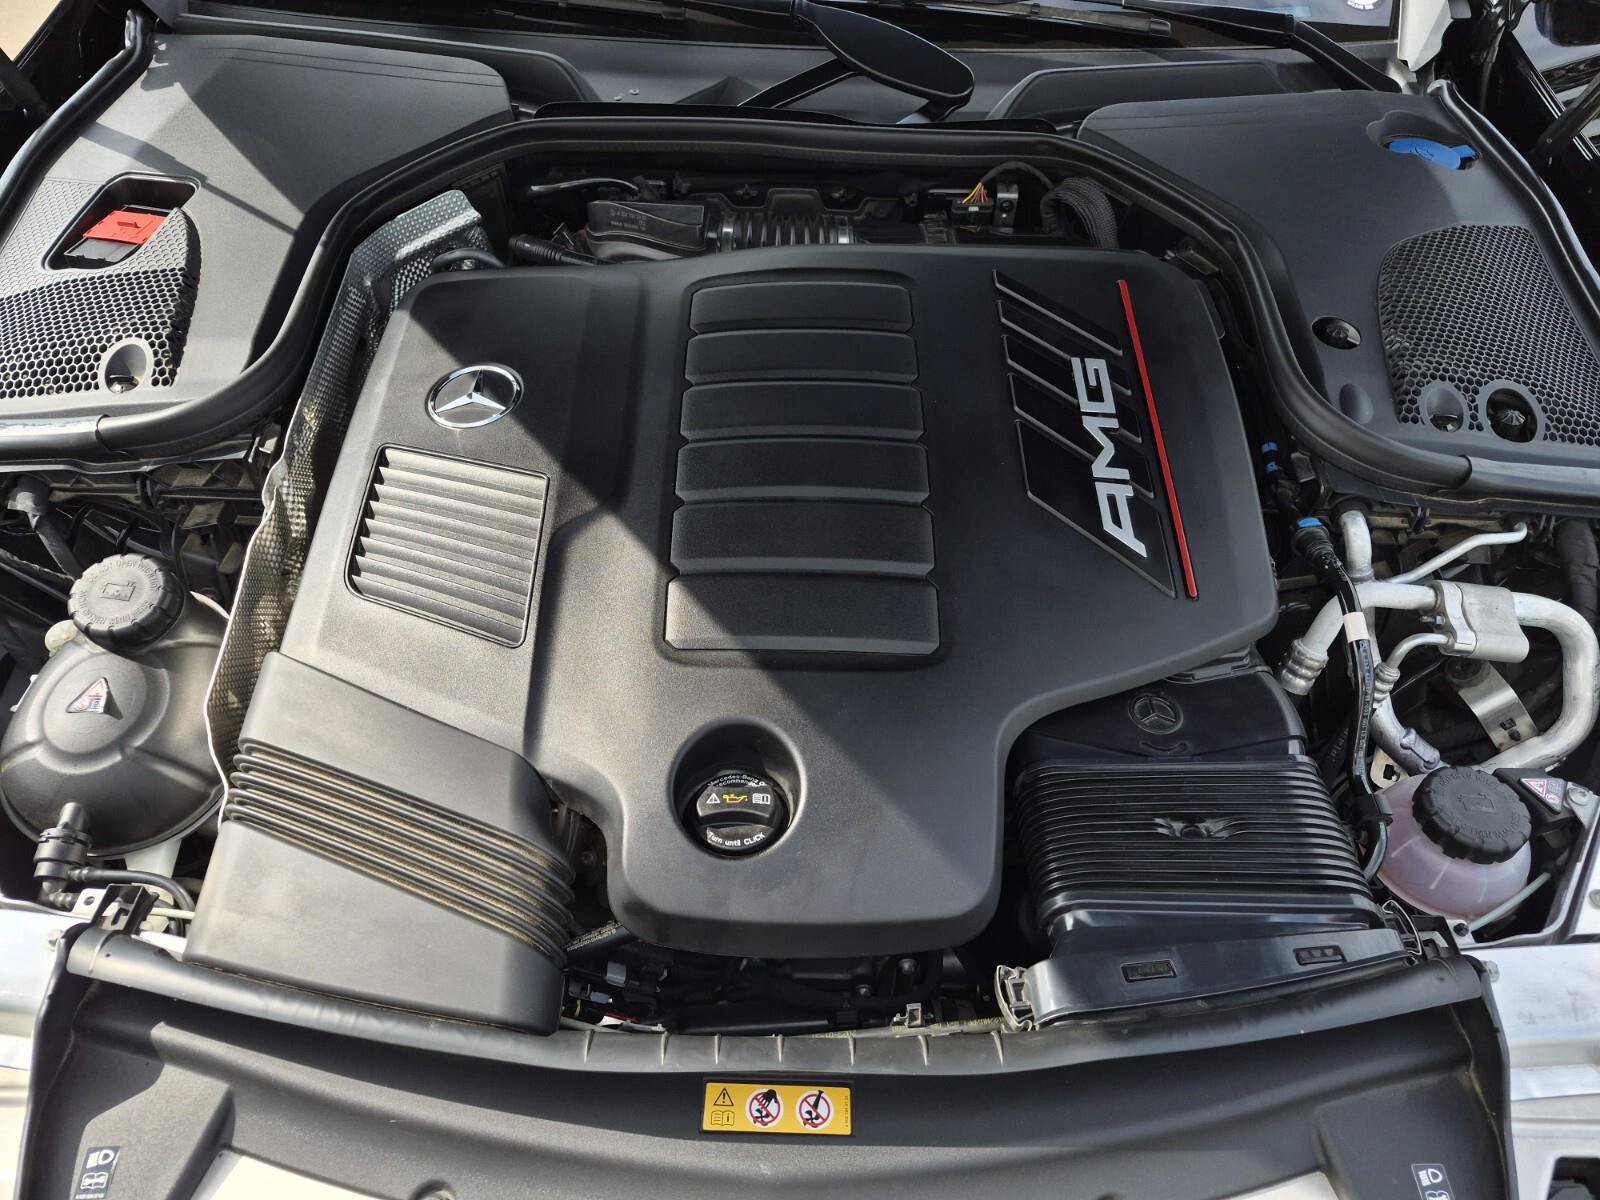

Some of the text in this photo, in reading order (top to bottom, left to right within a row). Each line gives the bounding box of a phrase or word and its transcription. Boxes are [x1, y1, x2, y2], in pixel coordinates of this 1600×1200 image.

[1071, 357, 1148, 558] AMG
[709, 831, 766, 847] Turn until CLICK
